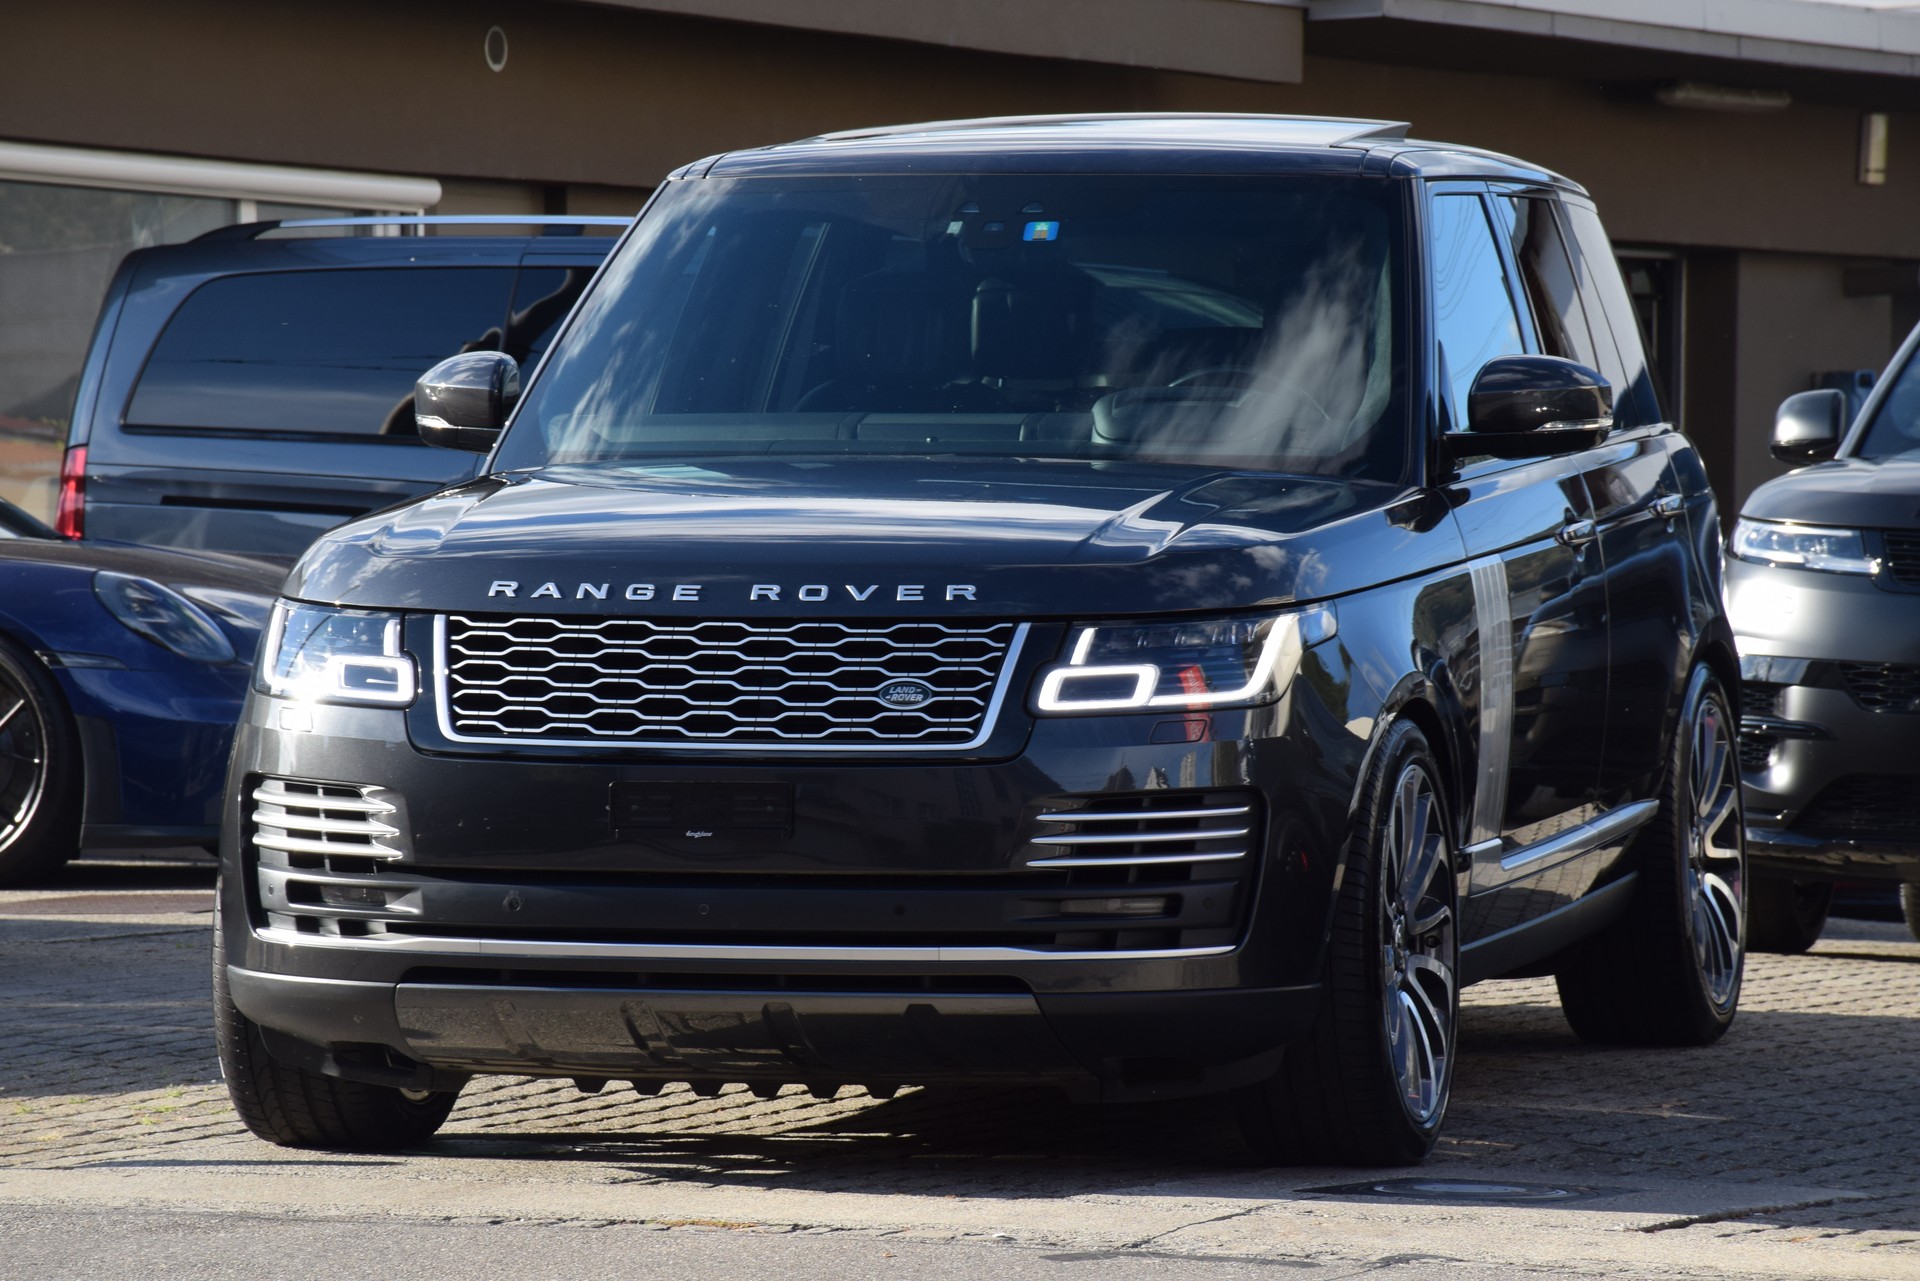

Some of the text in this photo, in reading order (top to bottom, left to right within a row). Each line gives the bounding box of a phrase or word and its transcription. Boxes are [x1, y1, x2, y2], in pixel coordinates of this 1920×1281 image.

[487, 580, 977, 602] RANGE ROVER
[889, 686, 915, 694] LAND
